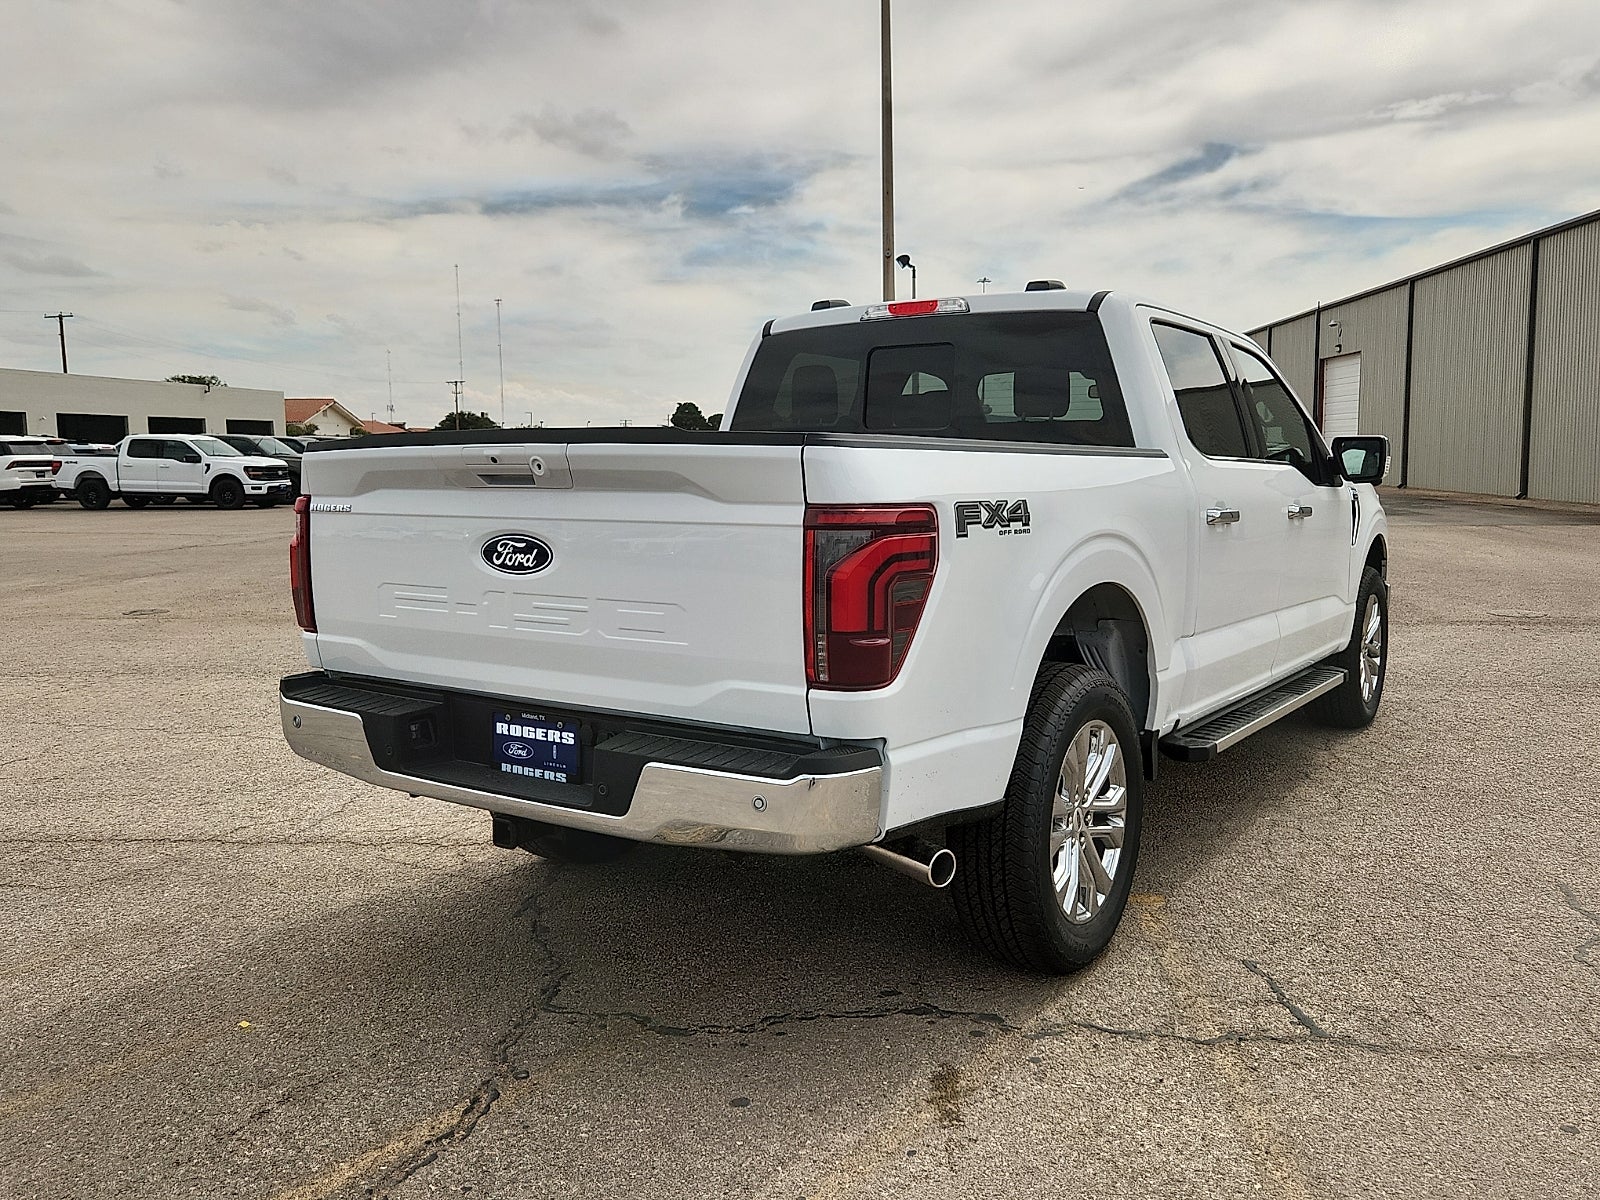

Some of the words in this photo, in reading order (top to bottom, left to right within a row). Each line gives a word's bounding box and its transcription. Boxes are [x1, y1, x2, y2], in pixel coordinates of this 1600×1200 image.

[310, 503, 352, 512] ROGERS
[954, 499, 1031, 539] FX4
[493, 539, 538, 567] Ford
[496, 722, 575, 745] ROGERS
[501, 762, 567, 783] ROGERS
